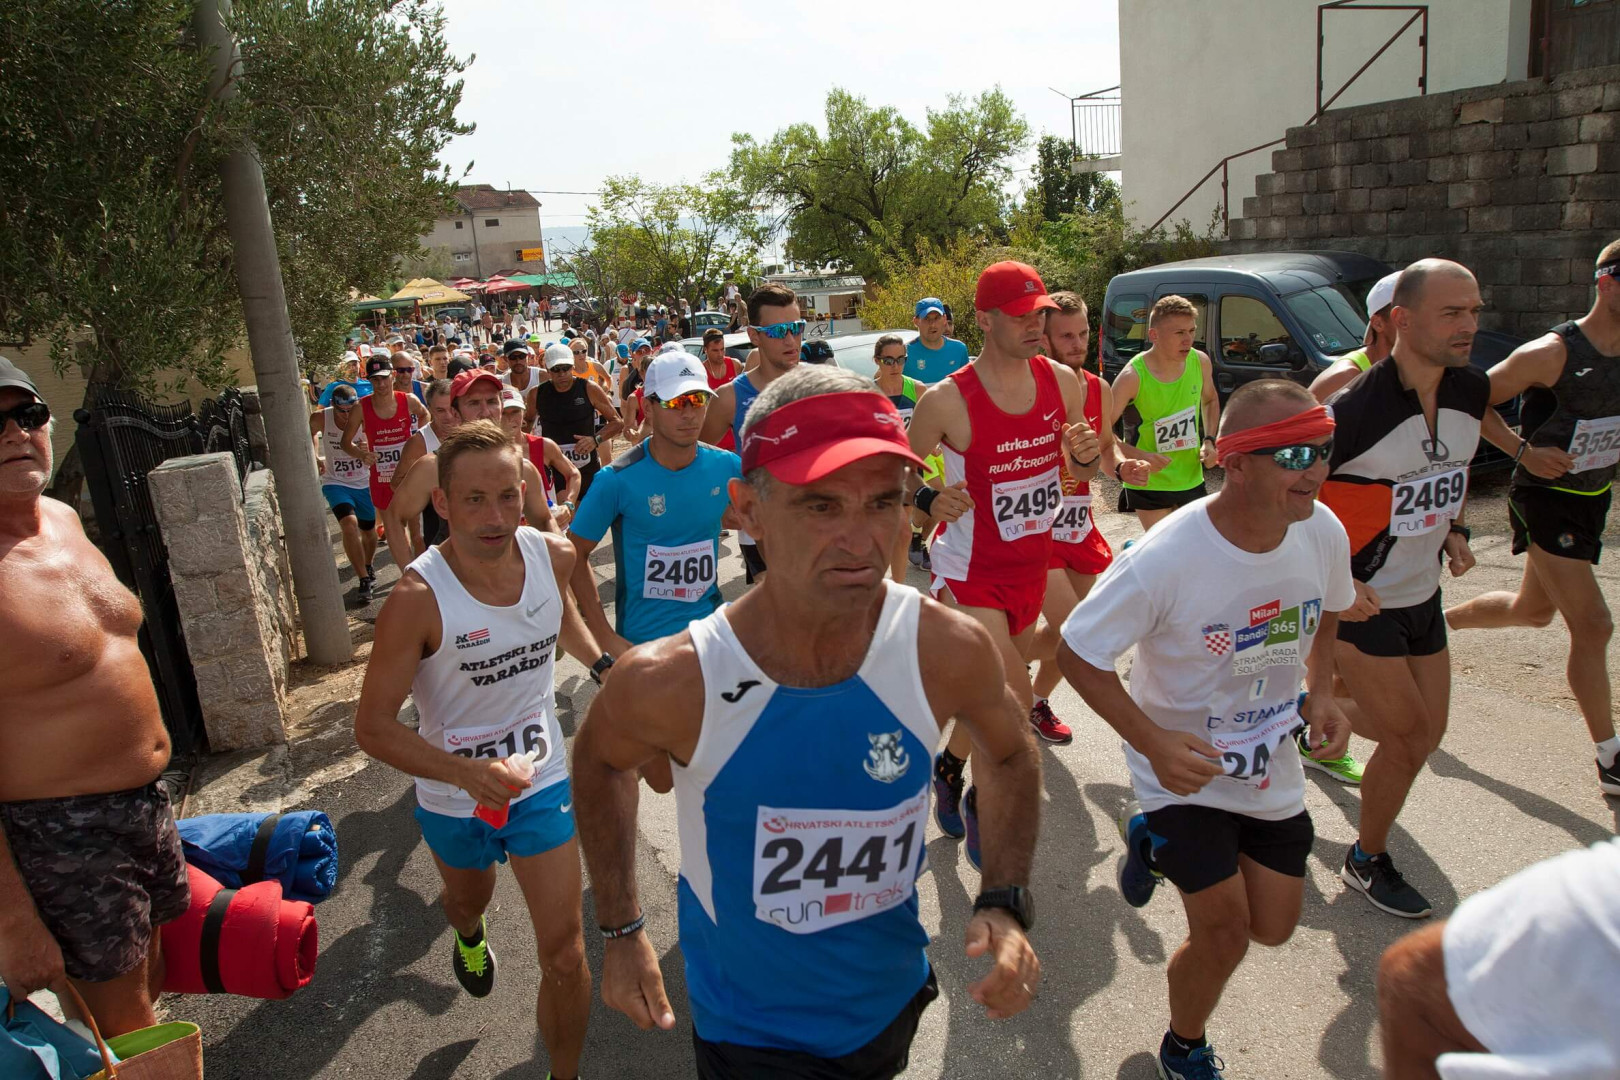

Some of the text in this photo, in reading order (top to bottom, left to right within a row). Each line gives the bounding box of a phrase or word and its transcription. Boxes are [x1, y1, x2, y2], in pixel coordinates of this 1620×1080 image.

[376, 427, 403, 435] utrka.com
[1156, 415, 1197, 445] 2471
[996, 432, 1055, 453] utrka.com
[376, 449, 401, 464] 250
[334, 459, 363, 472] 2513
[989, 462, 1013, 474] RUN
[1394, 472, 1464, 515] 2469
[995, 480, 1061, 523] 2495
[1052, 506, 1088, 528] 249
[1005, 523, 1025, 537] run
[1397, 519, 1425, 532] run
[647, 554, 713, 585] 2460
[649, 587, 674, 597] run
[1252, 607, 1278, 621] Milan
[1271, 620, 1297, 635] 365
[455, 633, 469, 645] AK
[456, 637, 491, 650] VARAŽDIN
[459, 633, 558, 671] ATLETSKI KLUB
[1271, 648, 1298, 657] RADA
[460, 733, 493, 743] HRVATSKI
[522, 711, 542, 722] SAVEZ
[1226, 734, 1260, 747] HRVATSKI
[784, 820, 842, 831] HRVATSKI
[844, 816, 898, 829] ATLETSKI
[760, 820, 916, 895] 2441
[769, 900, 823, 925] run
[853, 880, 904, 911] trek
